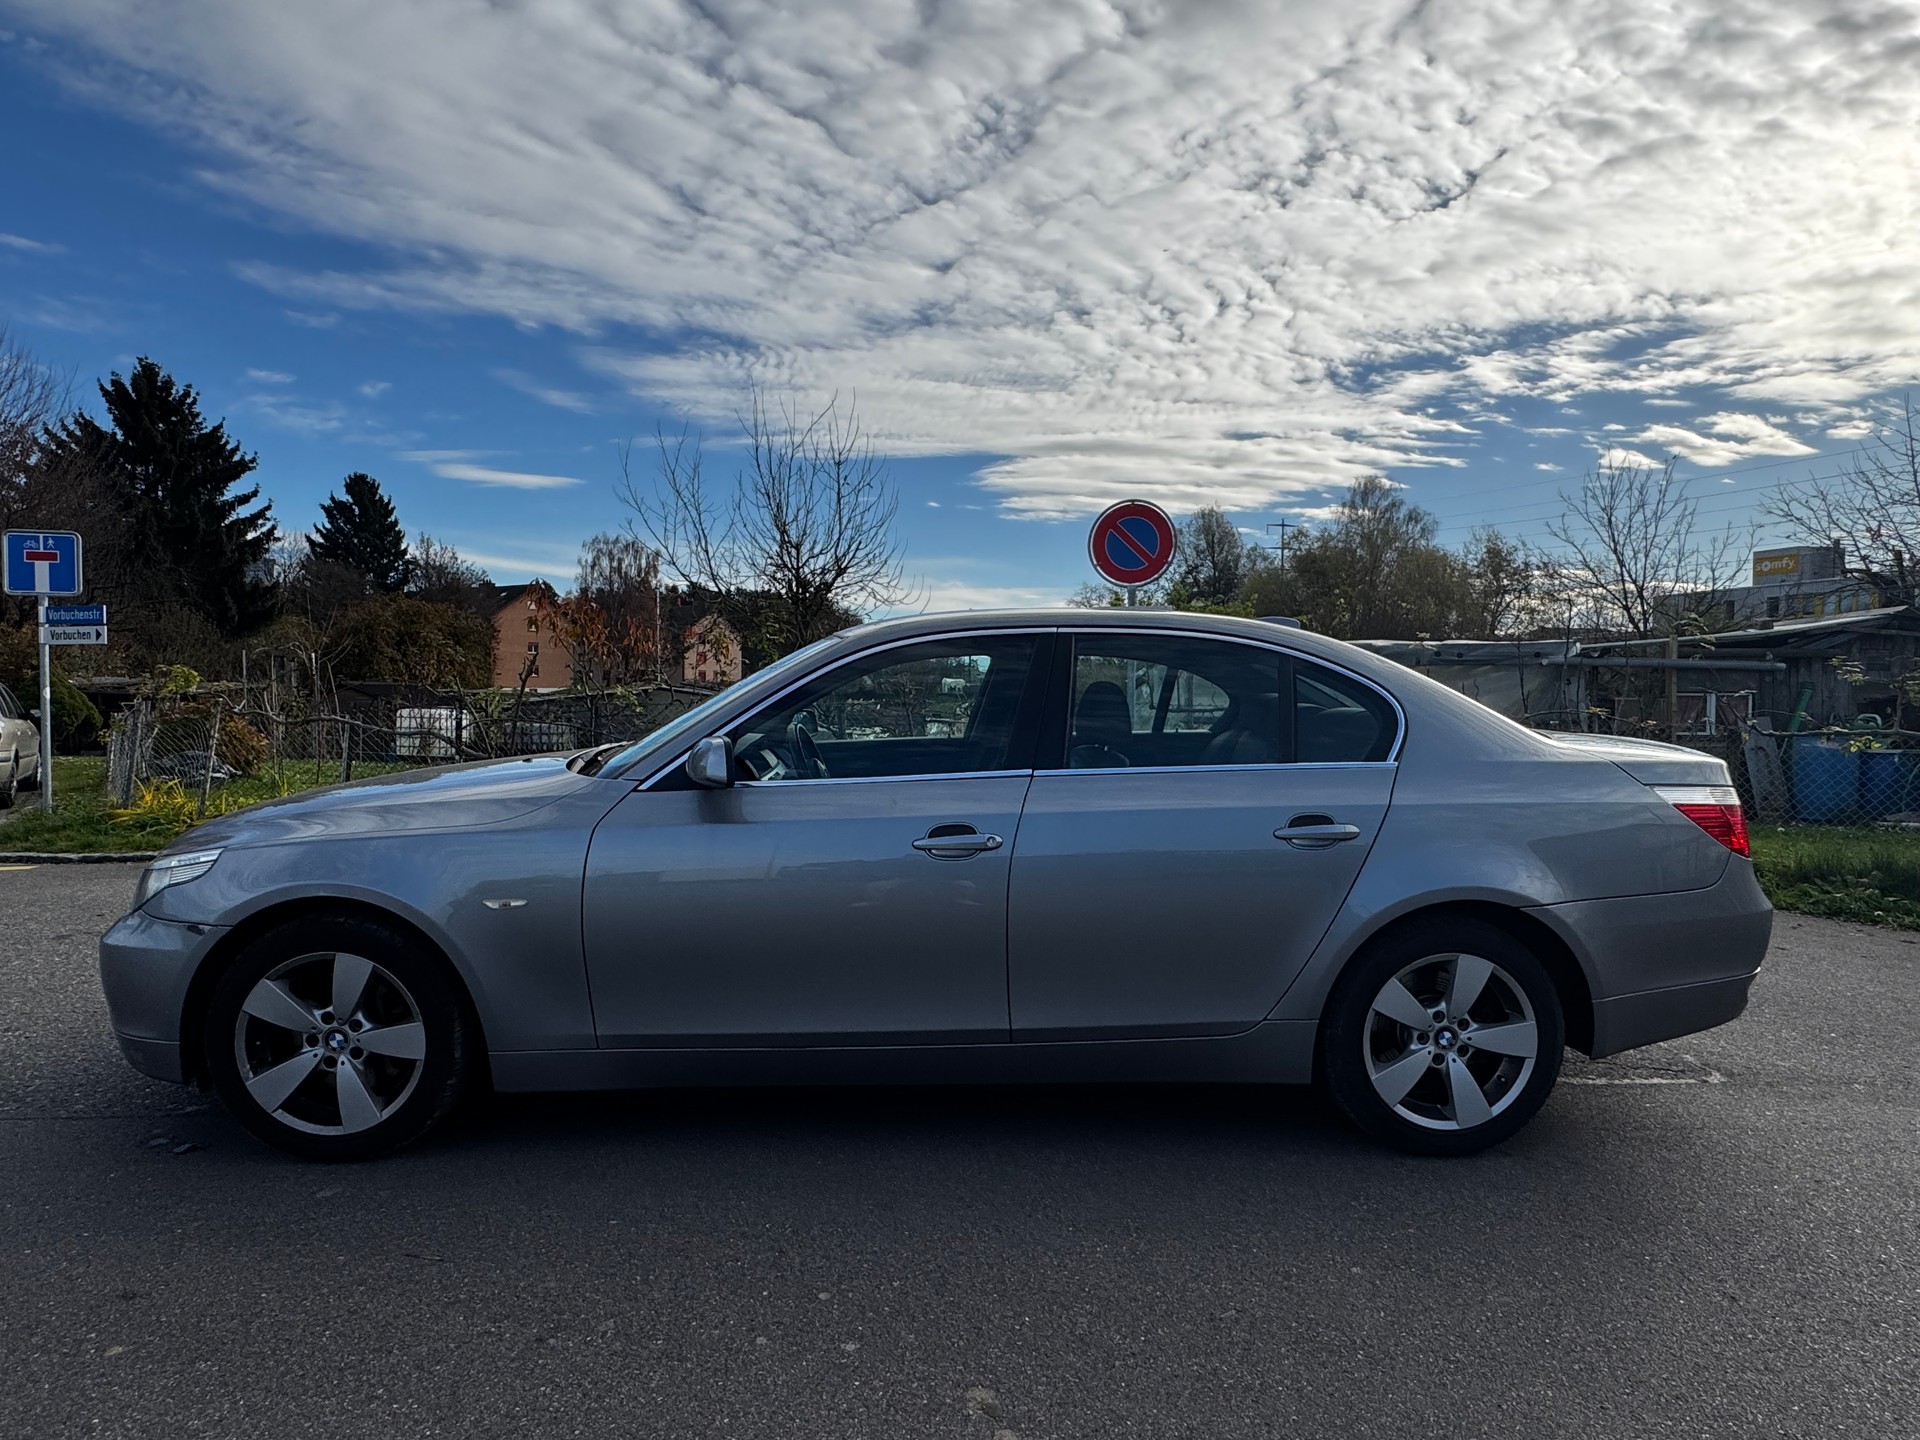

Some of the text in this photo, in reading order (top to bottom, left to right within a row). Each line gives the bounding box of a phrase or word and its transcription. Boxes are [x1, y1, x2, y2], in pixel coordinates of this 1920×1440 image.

[1755, 557, 1795, 572] somfy
[48, 609, 102, 620] Vorbuchenstr.
[50, 629, 91, 640] Vorbuchen
